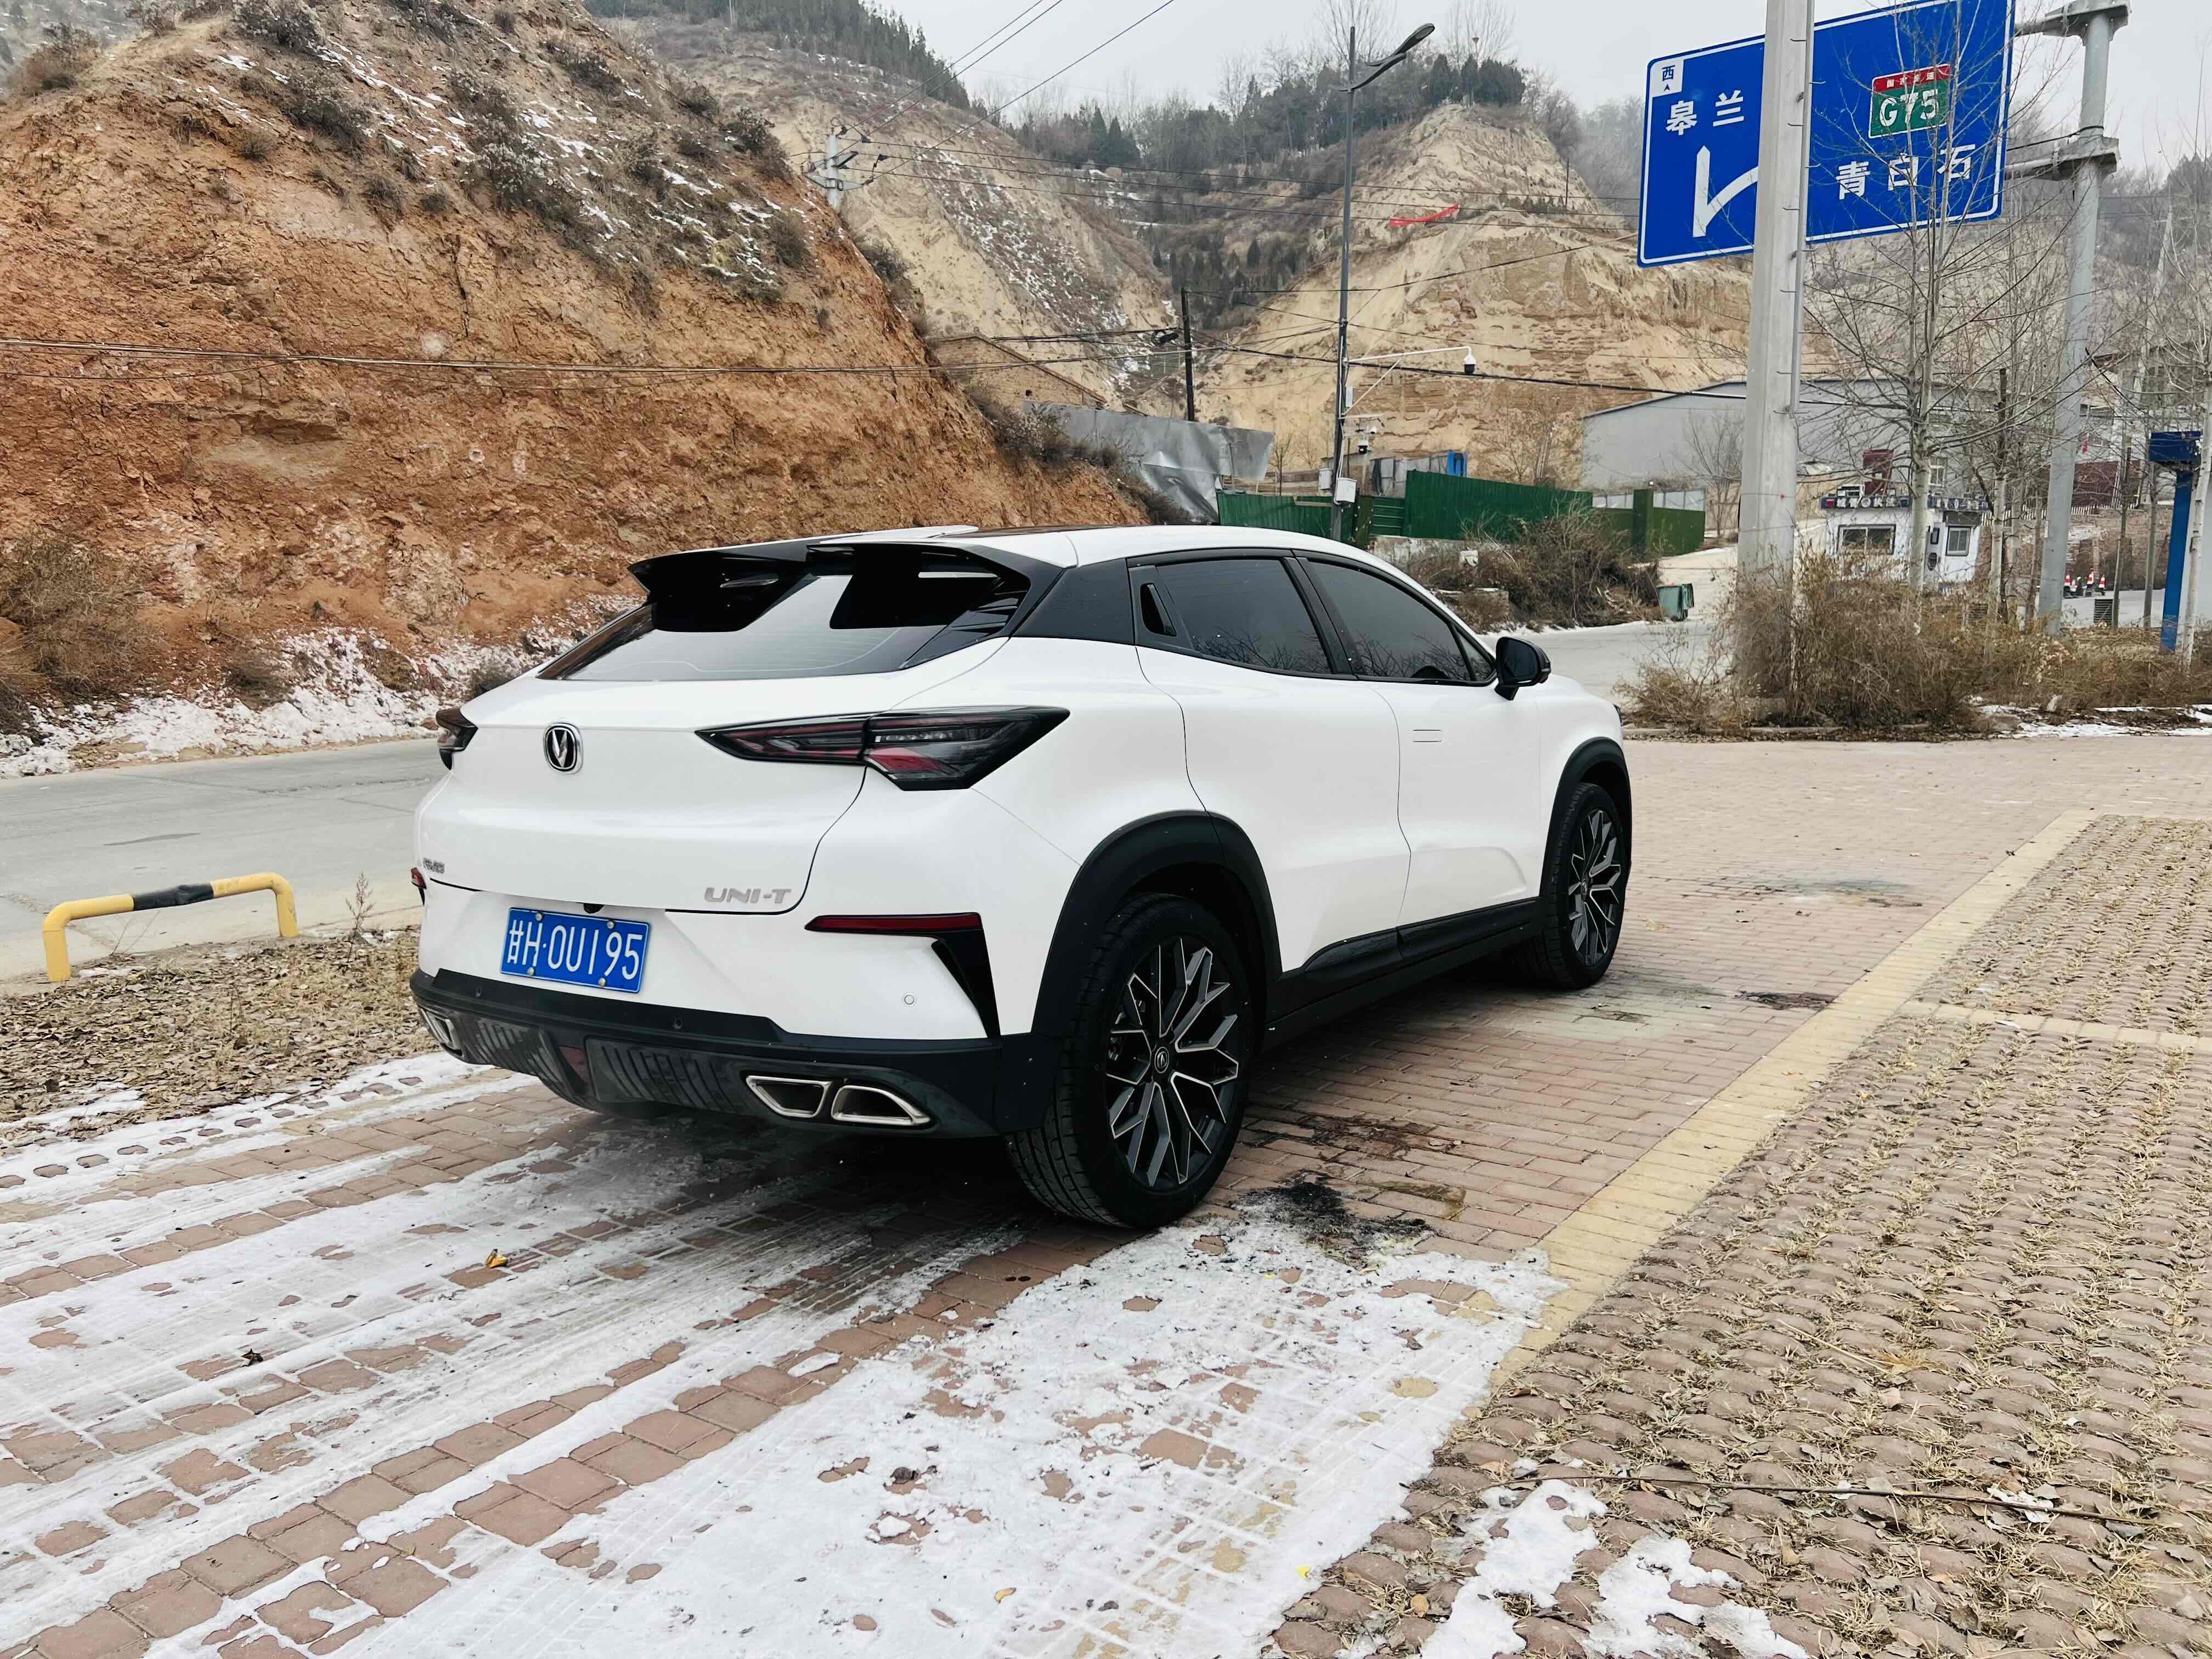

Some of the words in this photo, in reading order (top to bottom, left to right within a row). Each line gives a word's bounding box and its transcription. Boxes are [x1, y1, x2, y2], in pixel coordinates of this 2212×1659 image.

[1662, 65, 1675, 82] 西
[1666, 90, 1745, 136] 皋兰
[1880, 89, 1939, 127] G75
[1836, 144, 1976, 200] 青白石
[704, 887, 792, 904] UNI-T
